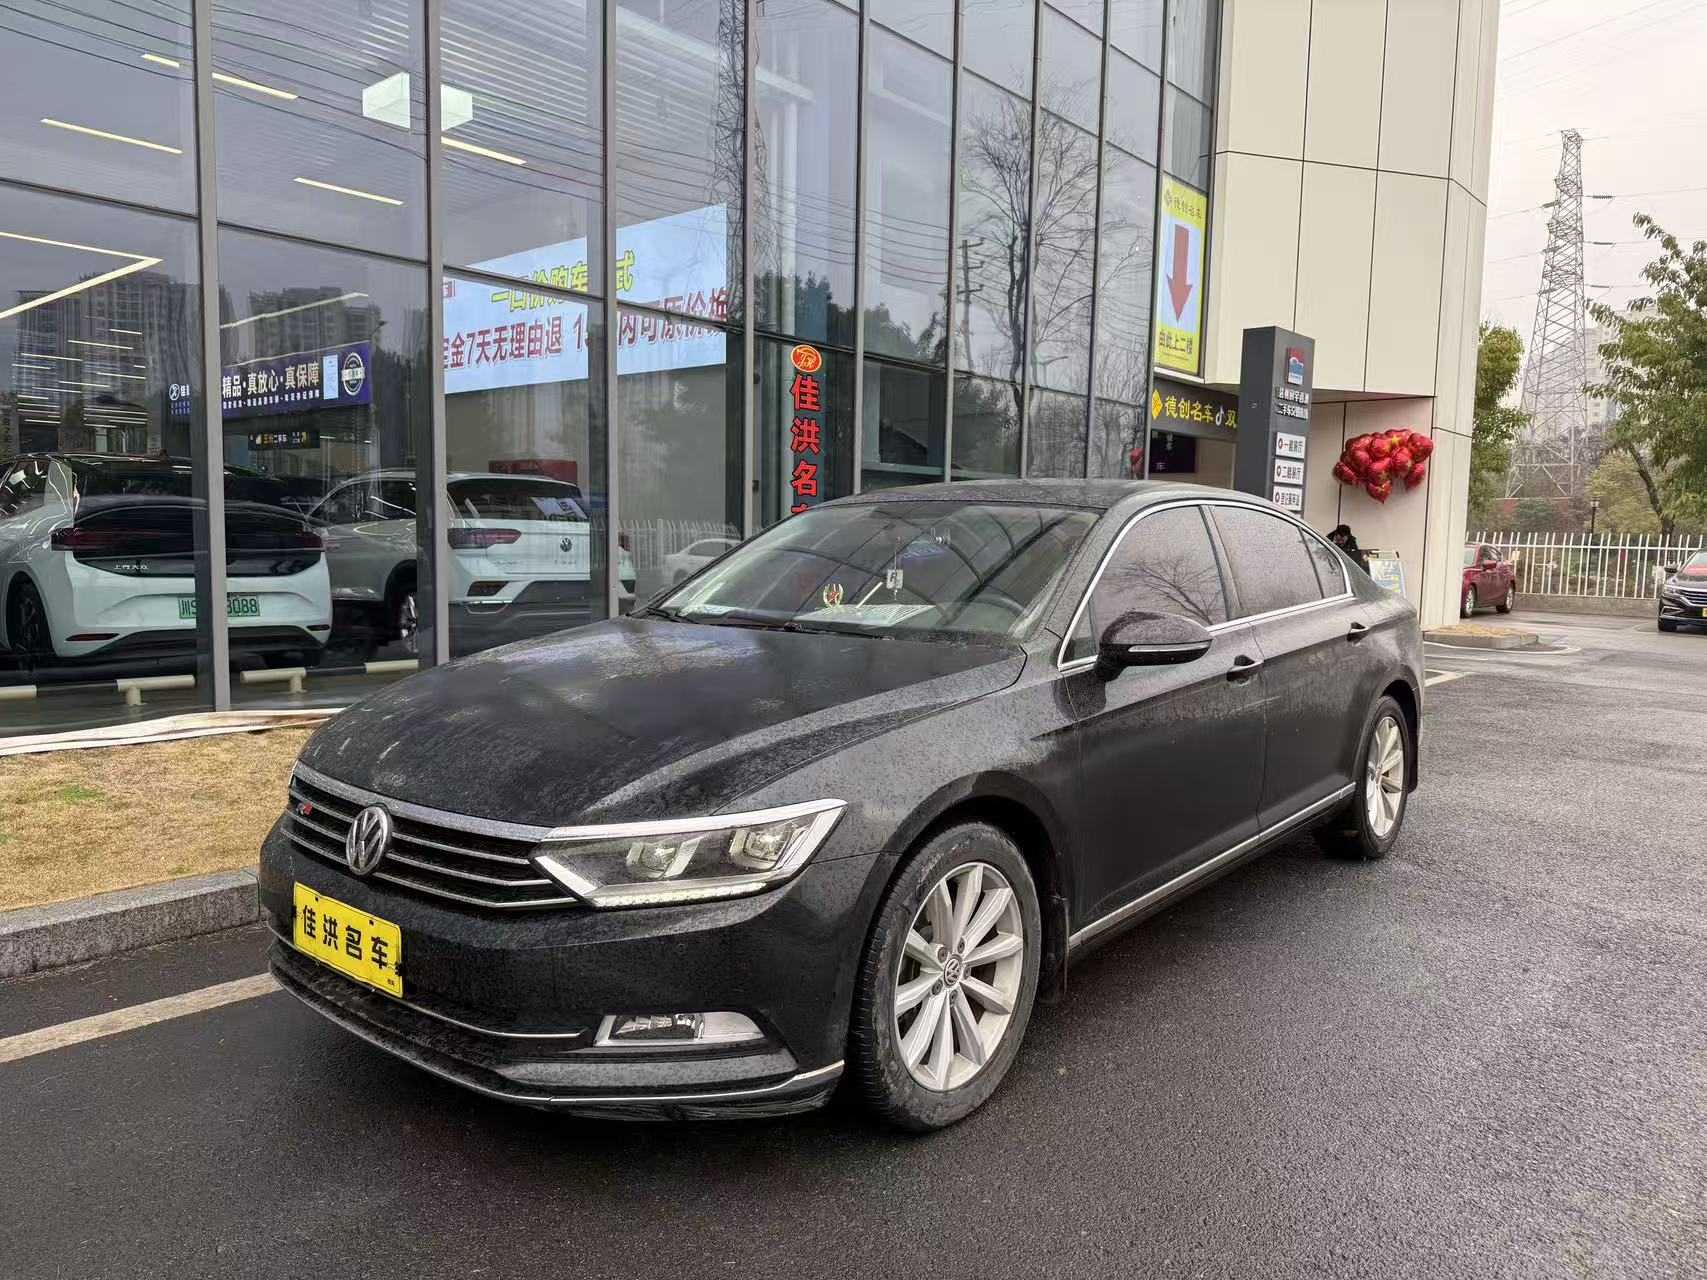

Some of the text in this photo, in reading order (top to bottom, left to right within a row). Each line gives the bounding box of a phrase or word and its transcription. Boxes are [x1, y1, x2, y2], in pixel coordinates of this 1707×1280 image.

[491, 250, 635, 312] 一口价购车式
[1164, 395, 1214, 424] 德创名车
[790, 374, 822, 514] 佳洪名
[302, 904, 389, 970] 佳洪名车
